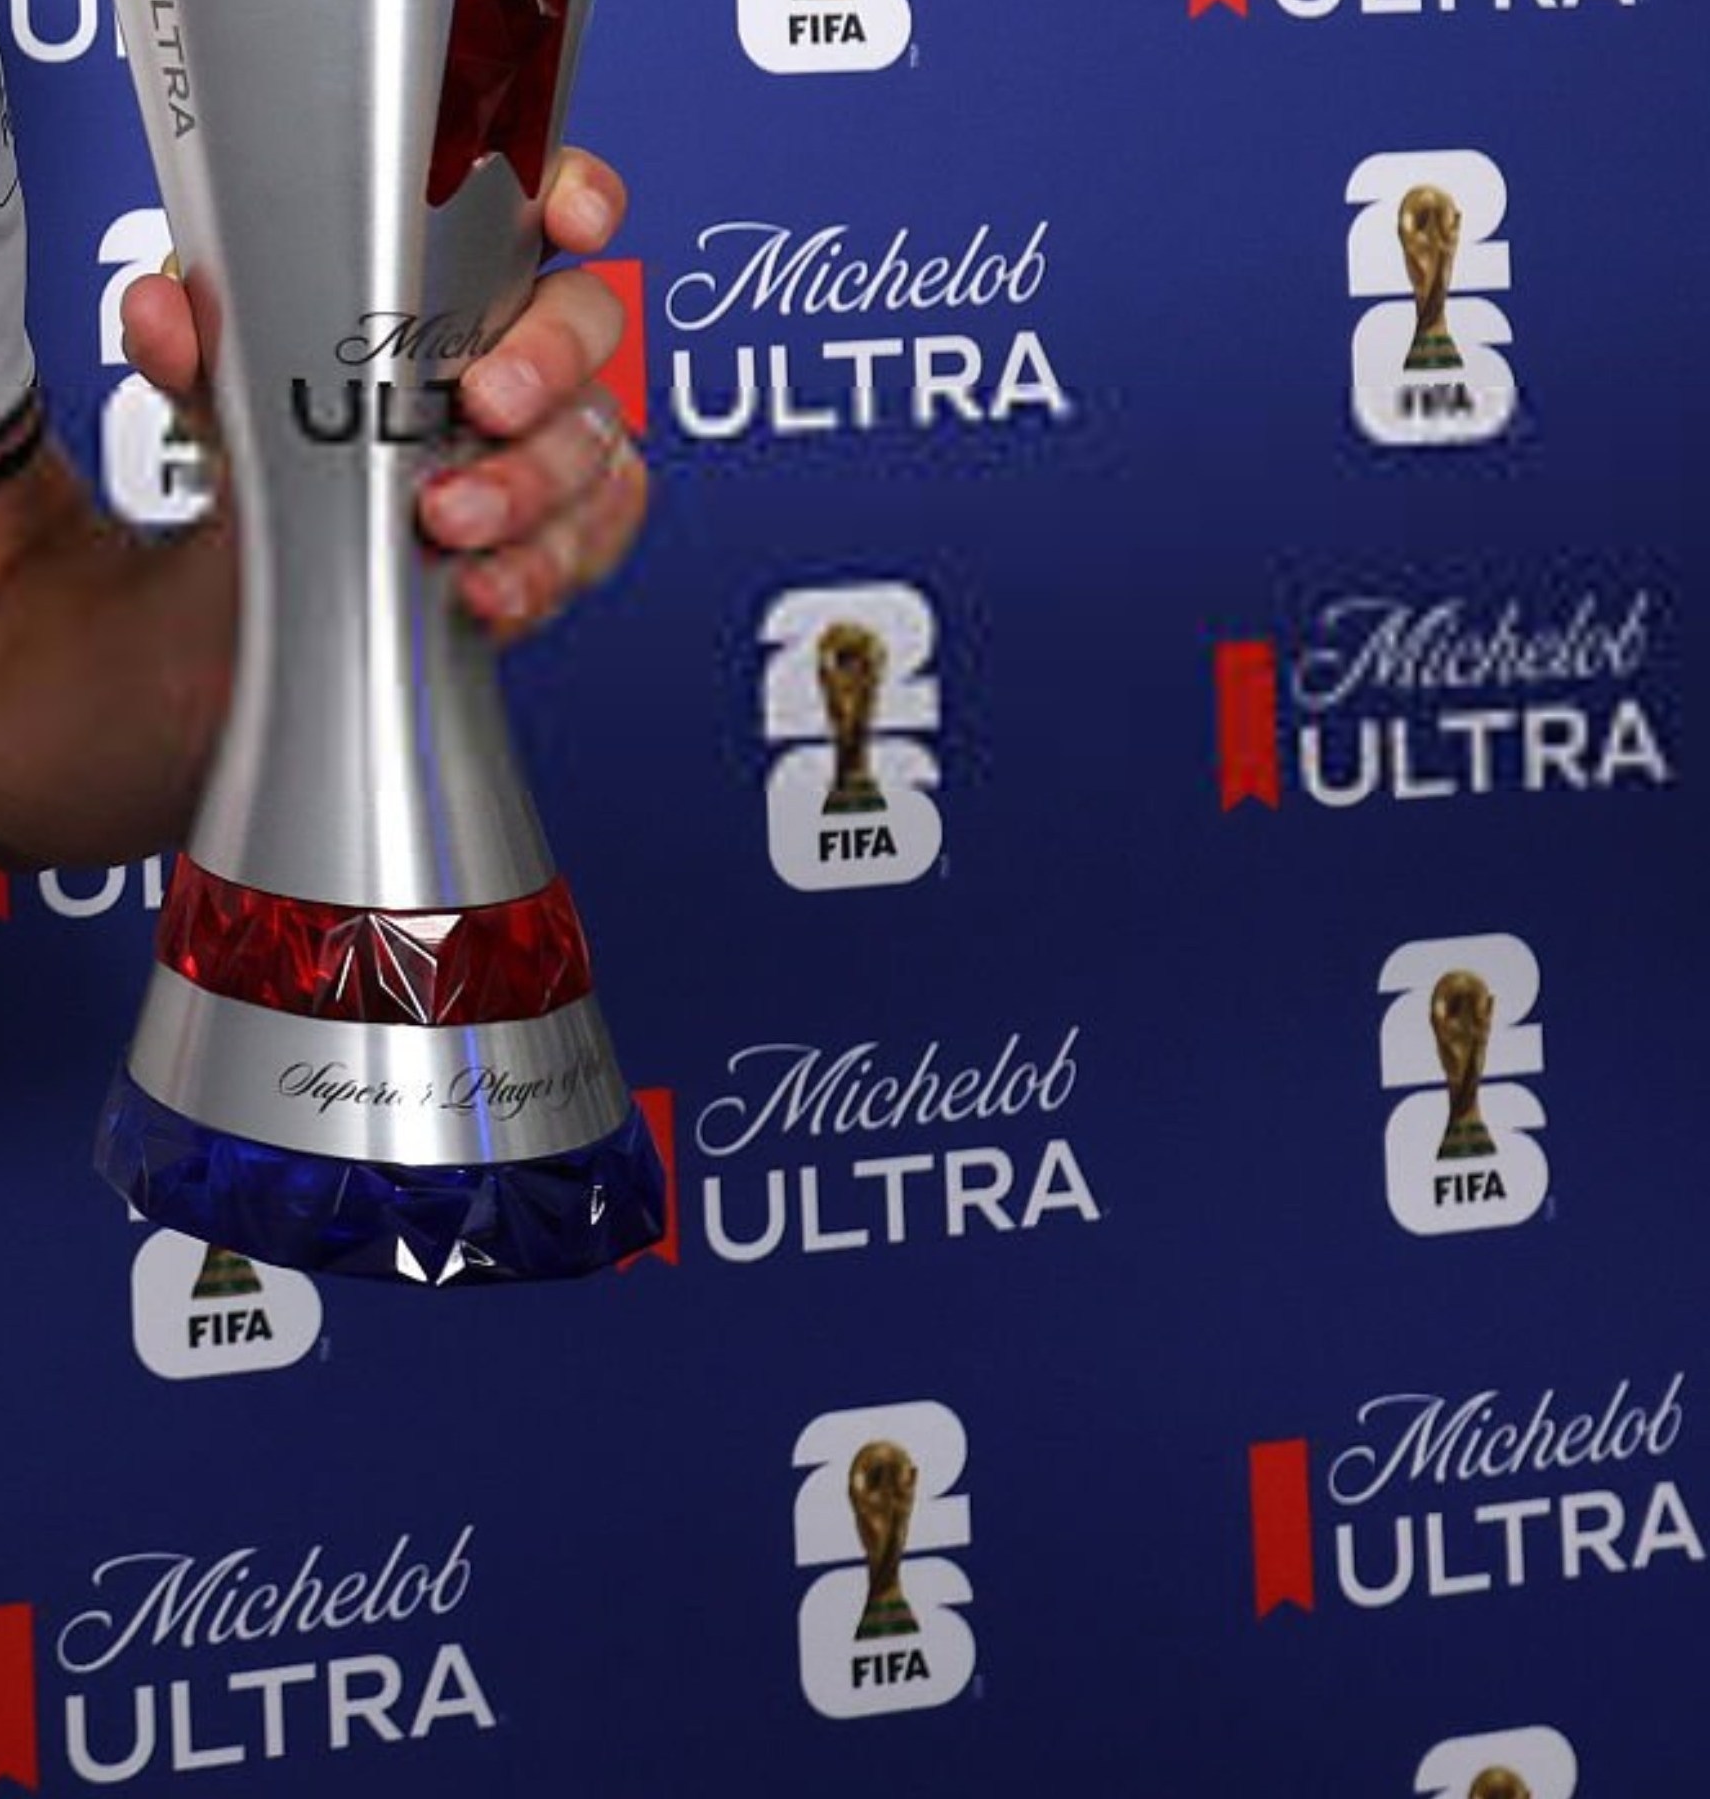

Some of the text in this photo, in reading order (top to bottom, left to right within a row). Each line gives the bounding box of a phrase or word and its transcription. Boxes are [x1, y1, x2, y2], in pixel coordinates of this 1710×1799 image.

[789, 14, 865, 44] FIFA
[666, 222, 1047, 330] Michelob
[335, 310, 494, 366] Mich
[673, 332, 1067, 436] ULTRA
[291, 378, 461, 443] ULT
[1301, 703, 1668, 808] ULTRA
[820, 827, 896, 861] FIFA
[697, 1027, 1078, 1155] Michelob
[704, 1140, 1100, 1261] ULTRA
[1435, 1171, 1505, 1205] FIFA
[188, 1308, 273, 1349] FIFA
[1329, 1373, 1683, 1504] Michelob
[1337, 1482, 1703, 1606] ULTRA
[58, 1526, 473, 1672] Michelob
[66, 1644, 495, 1782] ULTRA
[852, 1650, 929, 1688] FIFA
